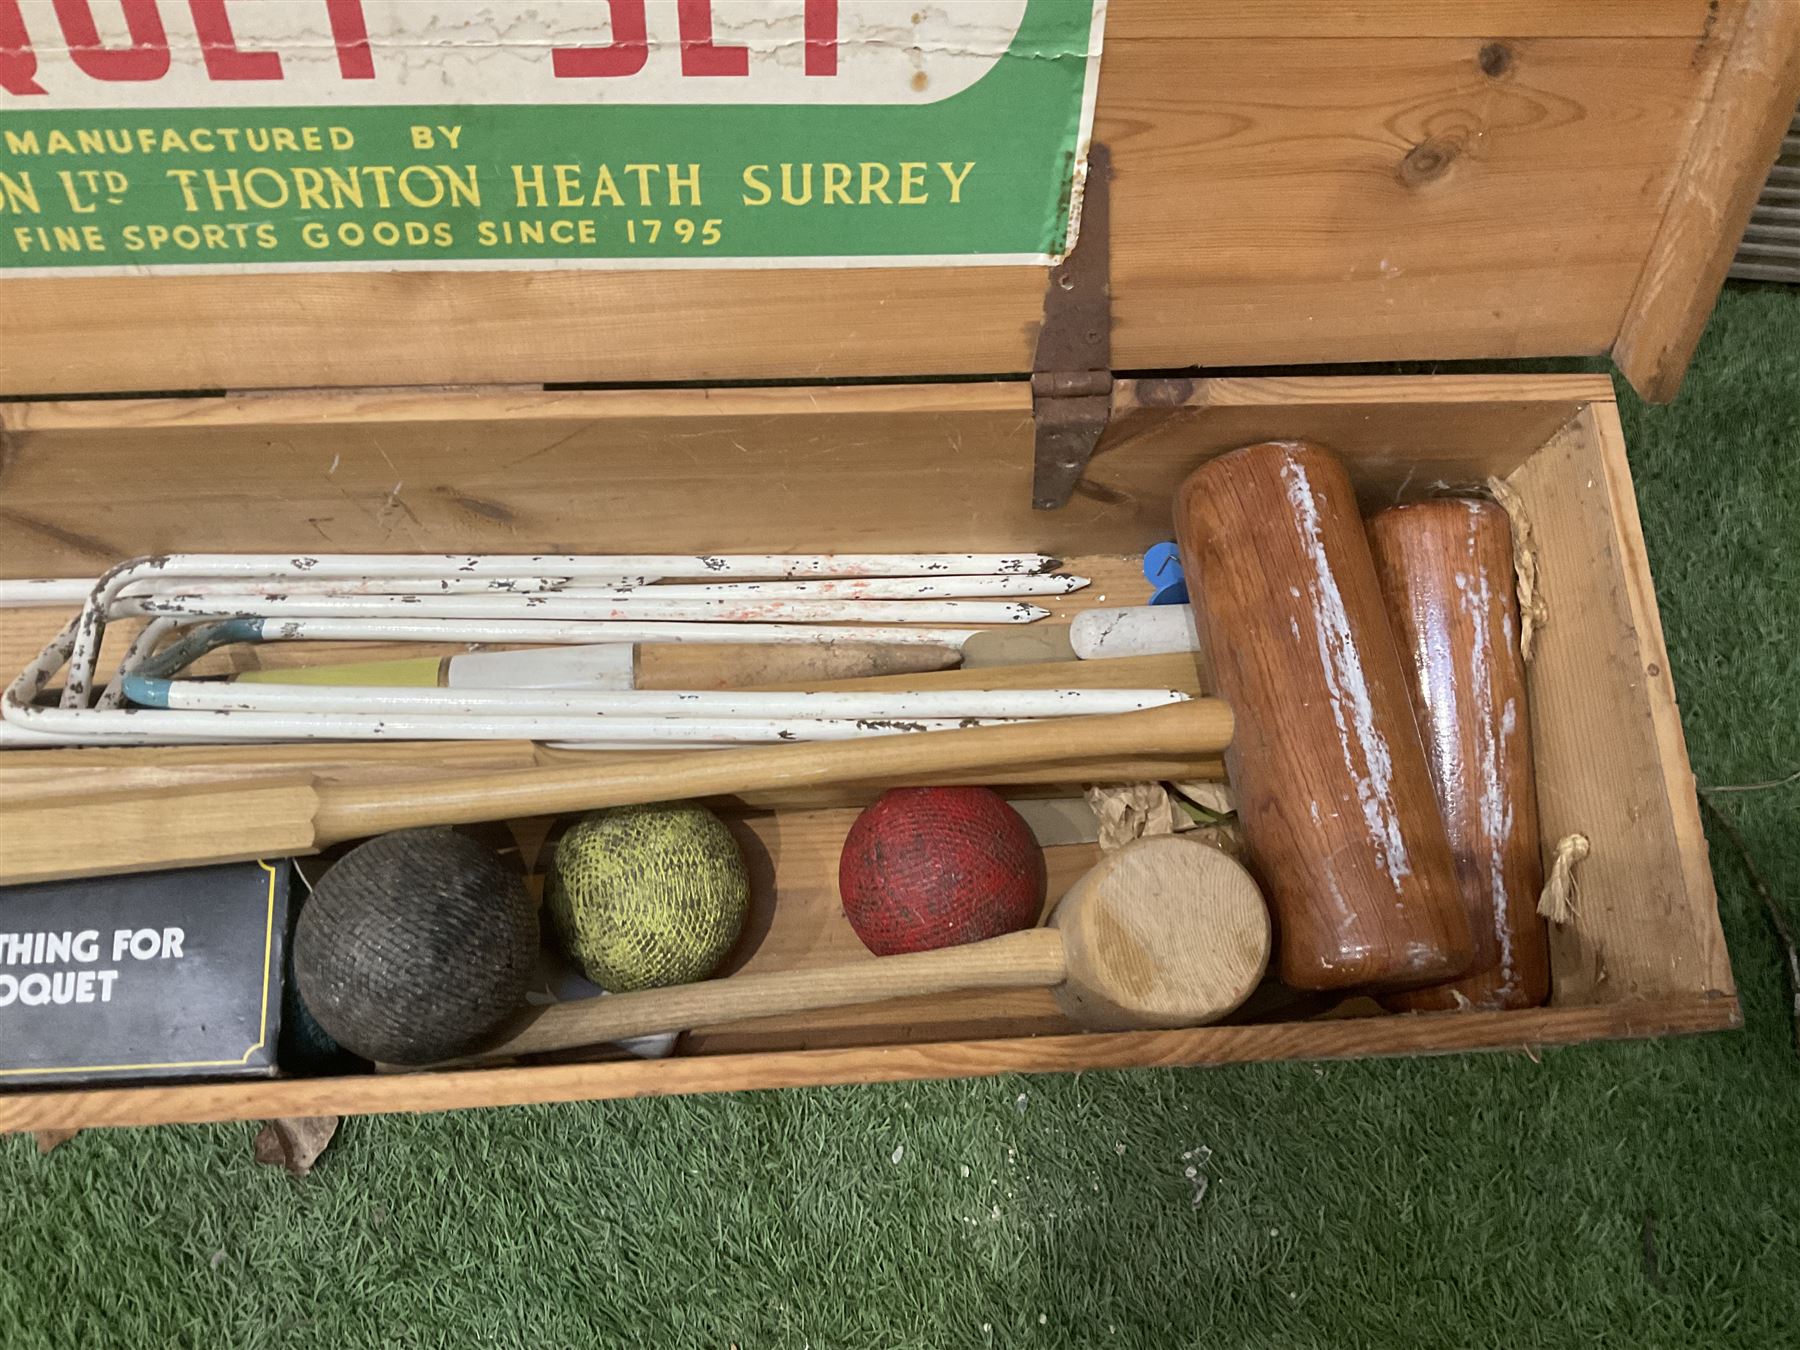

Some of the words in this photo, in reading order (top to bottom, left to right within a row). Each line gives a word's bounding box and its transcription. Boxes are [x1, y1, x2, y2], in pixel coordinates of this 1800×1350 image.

[4, 126, 354, 155] MANUFACTURED
[410, 126, 462, 149] BY
[0, 171, 41, 214] N
[166, 164, 481, 212] THORNTON
[511, 163, 702, 207] HEATH
[742, 161, 975, 206] SURREY
[14, 226, 105, 252] FINE
[122, 223, 278, 251] SPORTS
[302, 221, 453, 249] GOODS
[478, 219, 596, 246] SINCE
[627, 218, 722, 245] 1795
[112, 927, 185, 962] FOR
